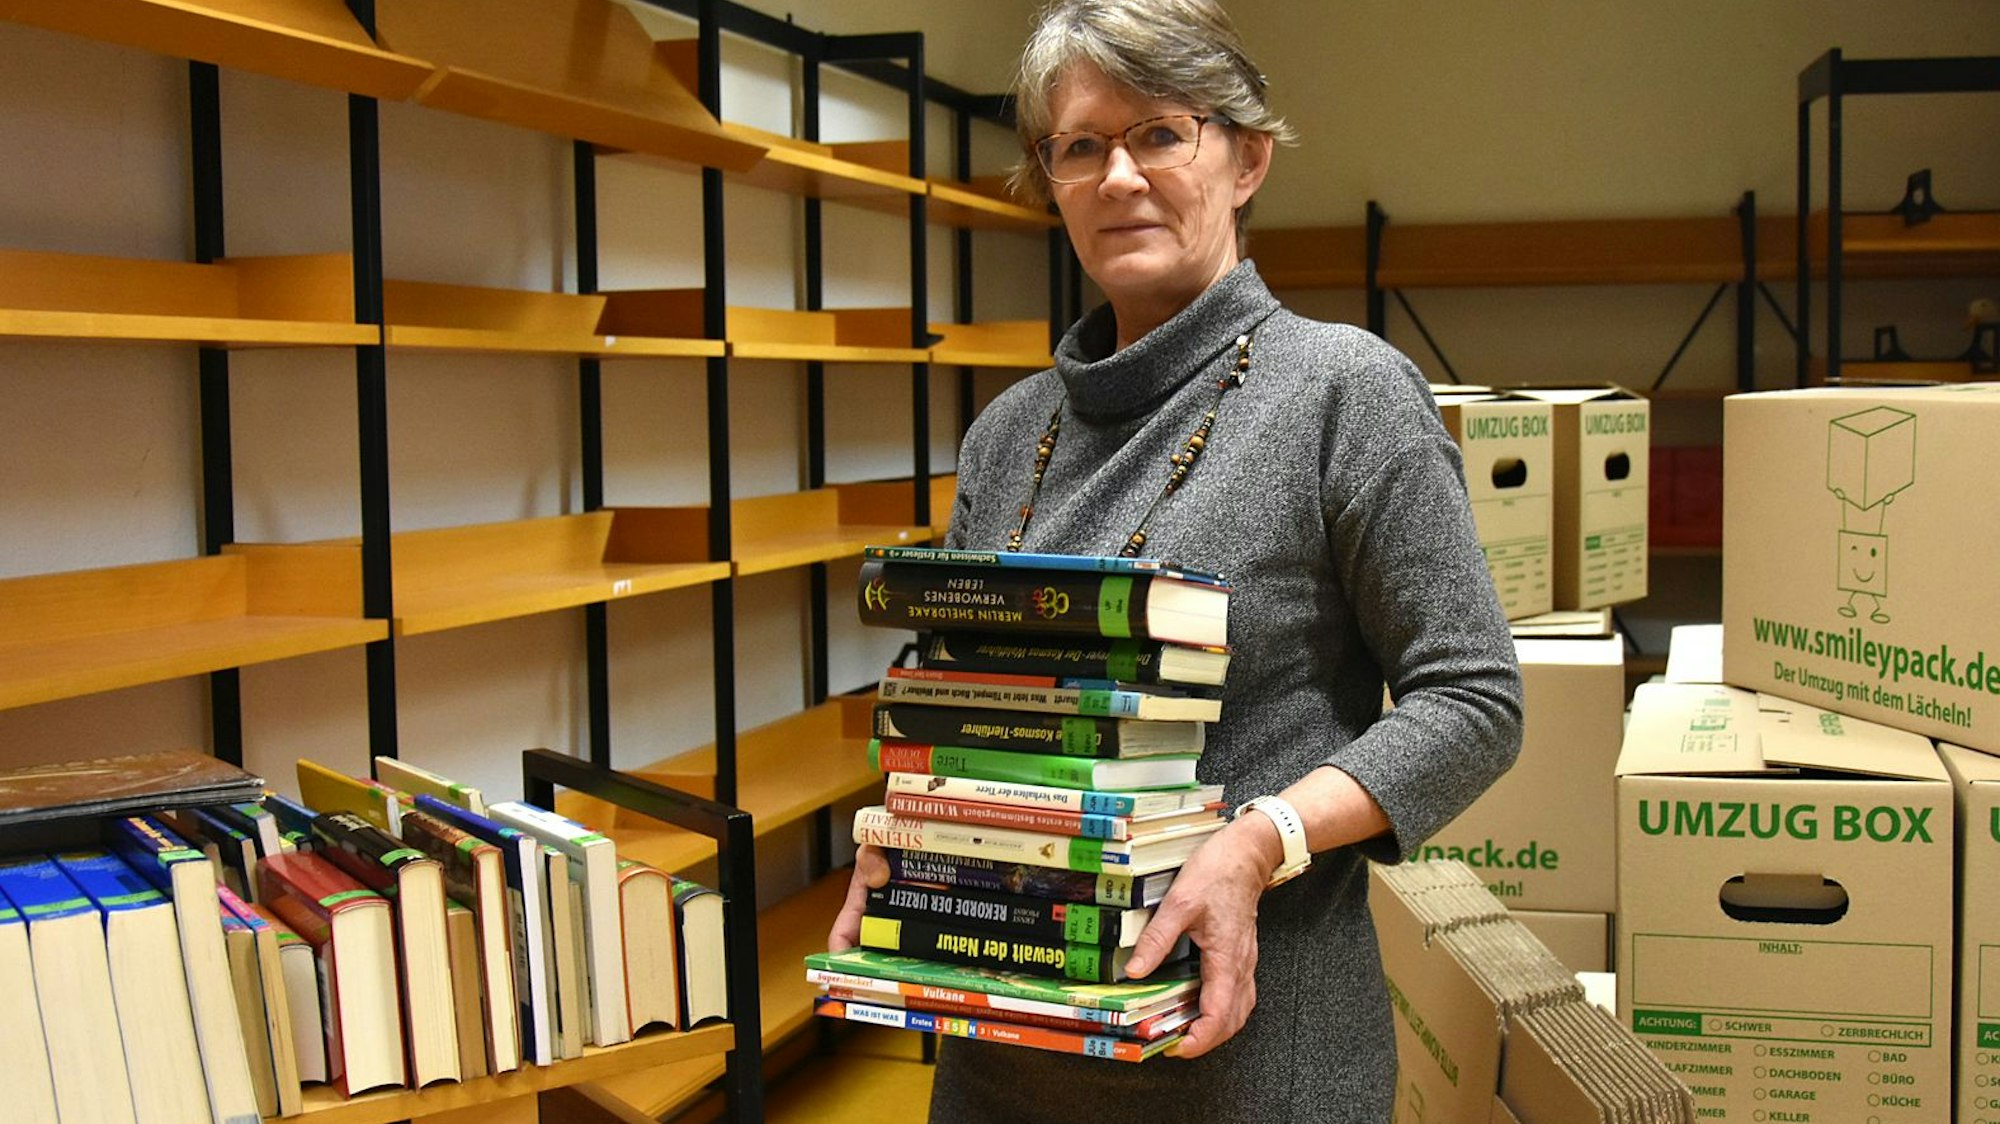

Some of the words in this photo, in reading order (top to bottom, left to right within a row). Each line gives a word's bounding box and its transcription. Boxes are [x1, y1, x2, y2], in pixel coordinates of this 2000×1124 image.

[1467, 416, 1519, 440] UMZUG
[1522, 415, 1548, 437] BOX
[1586, 413, 1625, 435] UMZUG
[1627, 412, 1646, 433] BOX
[901, 551, 937, 562] Erstleser
[937, 551, 950, 562] für
[951, 552, 996, 563] Sachwissen
[947, 578, 984, 590] LEBEN
[924, 590, 1005, 606] VERWOBENES
[907, 605, 974, 620] SHELDRAKE
[978, 610, 1022, 622] MERLIN
[1753, 617, 2000, 695] www.smileypack.de
[902, 686, 934, 697] Weiher?
[935, 688, 950, 698] und
[951, 689, 970, 699] Bach
[972, 689, 1001, 702] Tümpel,
[1003, 692, 1011, 702] in
[1012, 691, 1029, 702] lebt
[1030, 694, 1047, 704] Was
[1774, 661, 1796, 683] Der
[1799, 668, 1843, 701] Umzug
[1847, 680, 1869, 702] mit
[1873, 685, 1903, 711] dem
[1908, 693, 1972, 728] Lächeln!
[961, 723, 1054, 742] Kosmos-Tierführer
[937, 755, 966, 773] Tiere
[976, 785, 996, 796] Tiere
[998, 787, 1012, 797] der
[1014, 789, 1052, 801] Verhalten
[1053, 793, 1068, 804] Das
[862, 812, 923, 830] MINERALE
[963, 808, 1034, 825] Bestimmungsbuch
[1037, 817, 1062, 827] erstes
[1639, 800, 1818, 840] UMZUG
[1833, 805, 1934, 844] BOX
[860, 827, 923, 849] STEINE
[902, 869, 938, 882] GROSSE
[939, 872, 957, 884] DER
[1486, 881, 1523, 897] eln!
[888, 888, 929, 911] URZEIT
[930, 894, 953, 914] DER
[955, 898, 1008, 922] REKORDE
[936, 933, 979, 958] Natur
[982, 939, 1008, 961] der
[1759, 942, 1803, 955] INHALT:
[1013, 942, 1066, 970] Gewalt
[923, 986, 966, 1003] Vulkane
[853, 1008, 869, 1017] WAS
[870, 1010, 882, 1019] IST
[883, 1012, 899, 1022] WAS
[911, 1016, 933, 1028] Erstes
[934, 1017, 977, 1035] LESEN
[992, 1028, 1021, 1040] Vulkane
[1638, 1016, 1697, 1029] ACHTUNG:
[1725, 1021, 1772, 1032] SCHWER
[1838, 1027, 1924, 1040] ZERBRECHLICH
[1646, 1040, 1732, 1053] KINDERZIMMER
[1769, 1047, 1835, 1059] ESSZIMMER
[1882, 1052, 1907, 1063] BAD
[1665, 1062, 1733, 1075] LAFZIMMER
[1769, 1069, 1842, 1082] DACHBODEN
[1882, 1073, 1915, 1085] BÜRO
[1769, 1089, 1816, 1101] GARAGE
[1882, 1094, 1921, 1107] KÜCHE
[1769, 1112, 1810, 1123] KELLER
